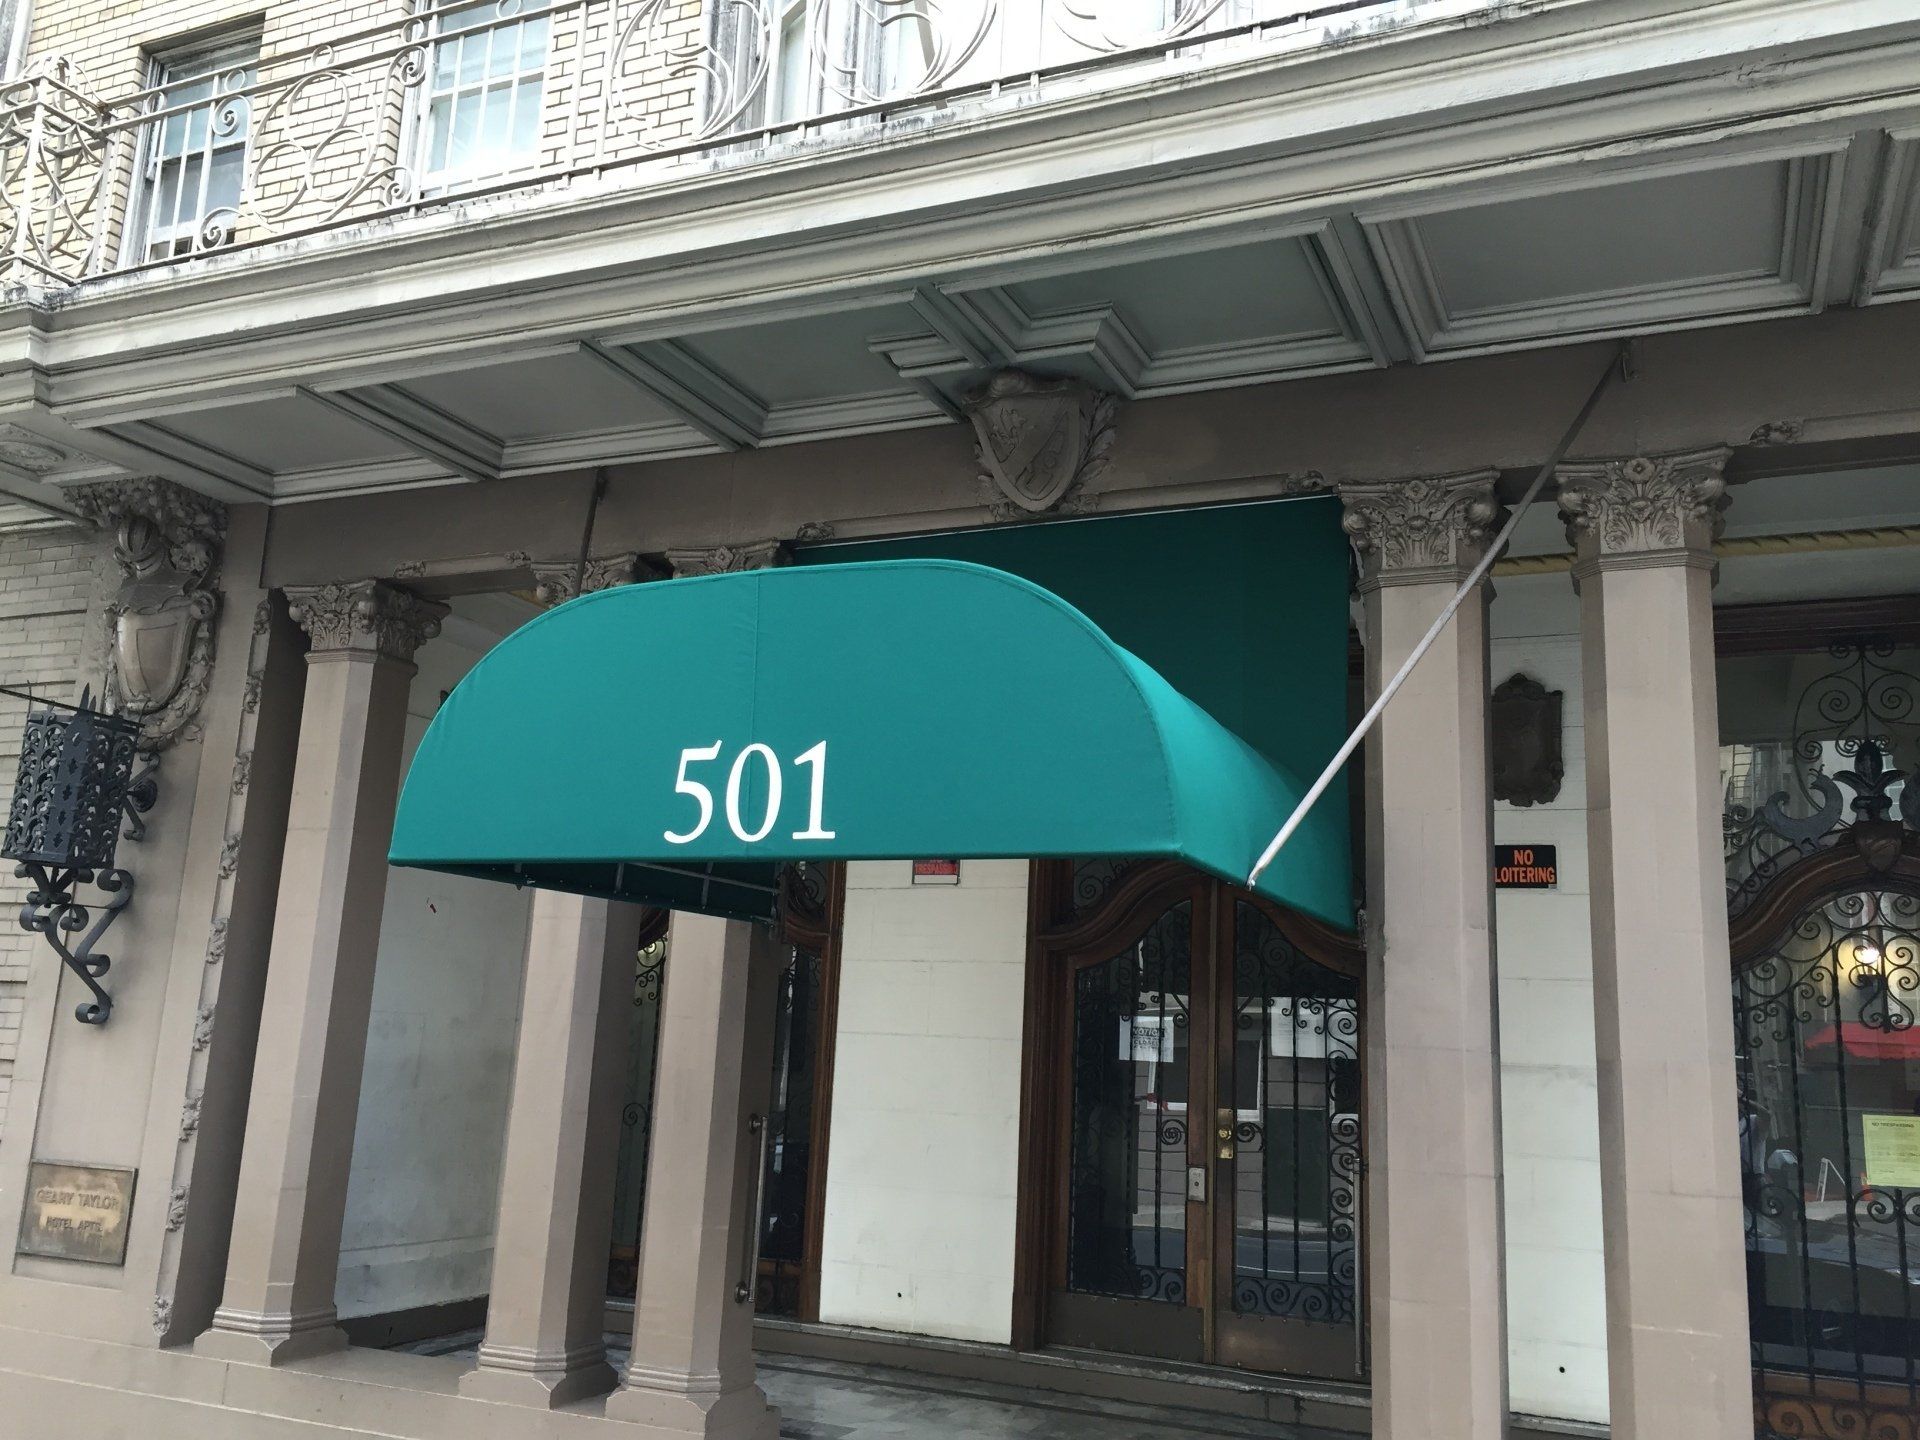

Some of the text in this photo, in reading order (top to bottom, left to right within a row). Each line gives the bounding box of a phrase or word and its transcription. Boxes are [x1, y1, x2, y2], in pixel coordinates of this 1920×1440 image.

[663, 739, 836, 844] 501
[1513, 849, 1534, 865] NO
[1494, 867, 1555, 883] LOITERING
[37, 1189, 119, 1210] GEARY TAYLOR
[46, 1215, 72, 1230] HOTEL
